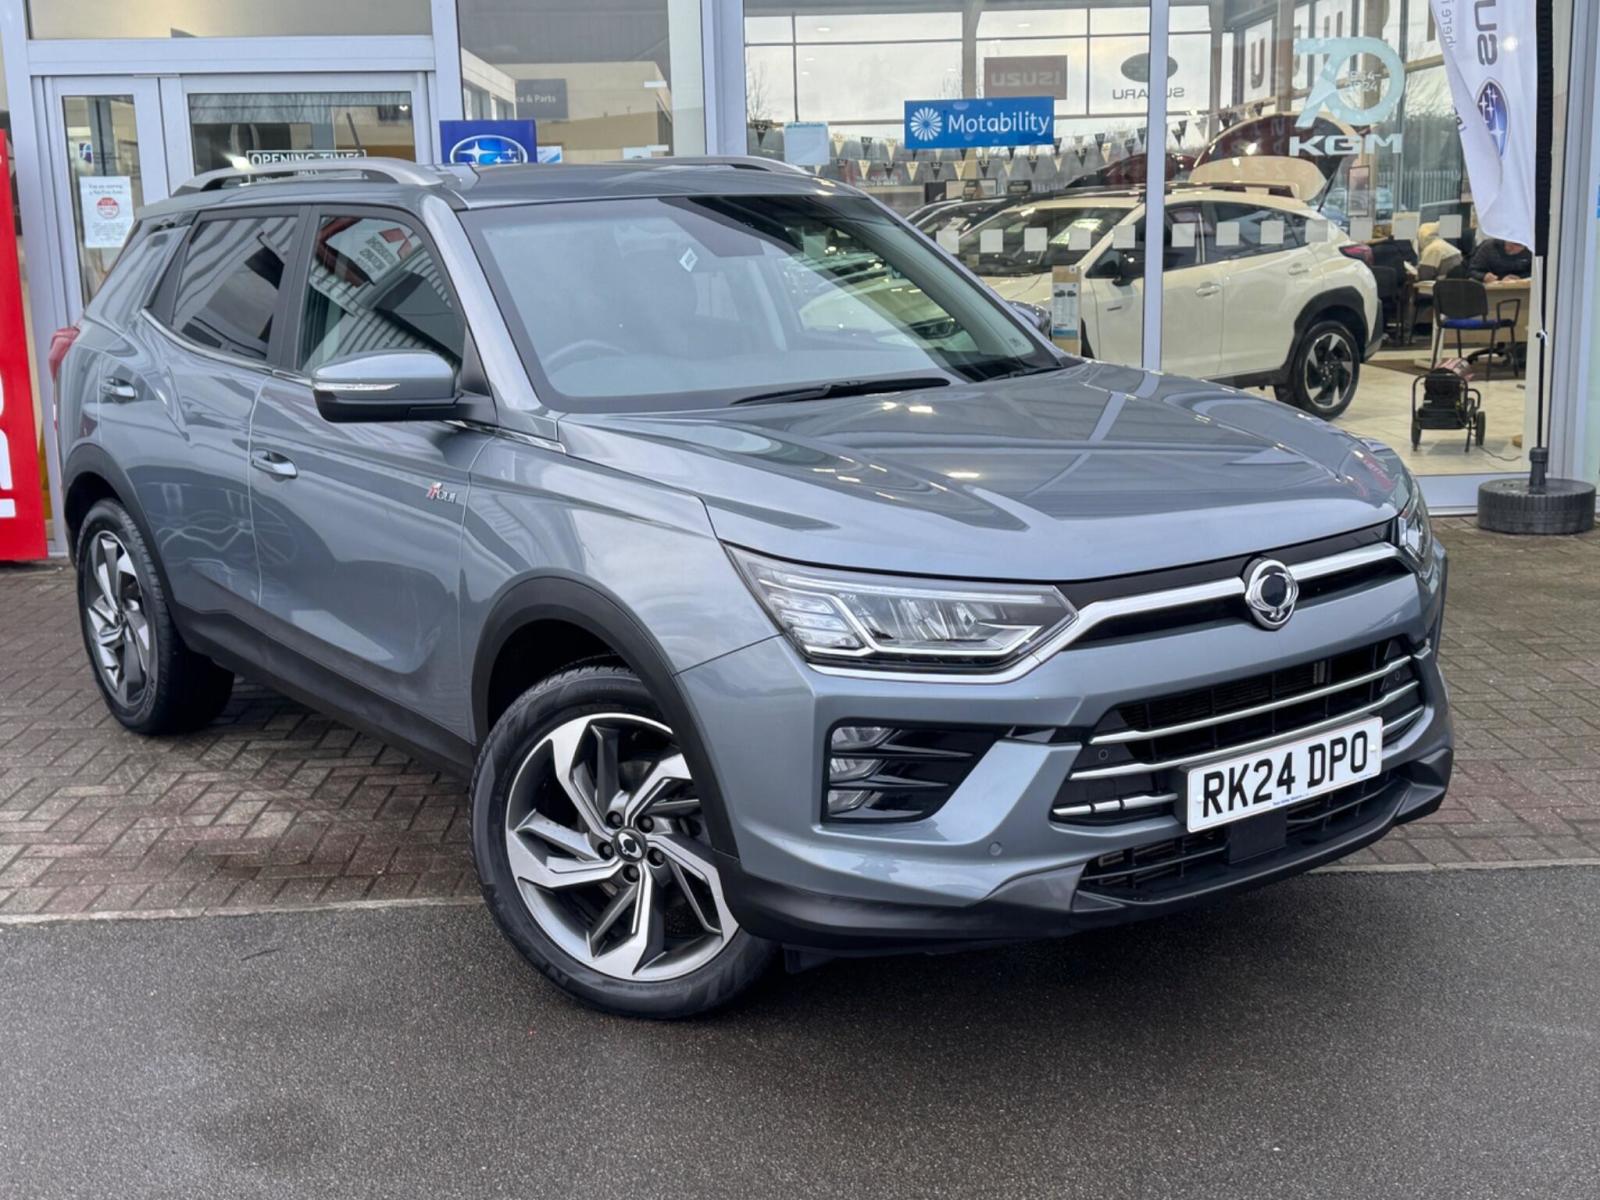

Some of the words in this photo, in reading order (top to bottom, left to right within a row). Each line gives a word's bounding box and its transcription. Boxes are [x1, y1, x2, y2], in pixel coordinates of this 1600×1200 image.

[948, 111, 1050, 136] Motability
[1289, 132, 1402, 157] KGM
[1203, 752, 1296, 818] RK24
[1307, 730, 1368, 789] DPO
